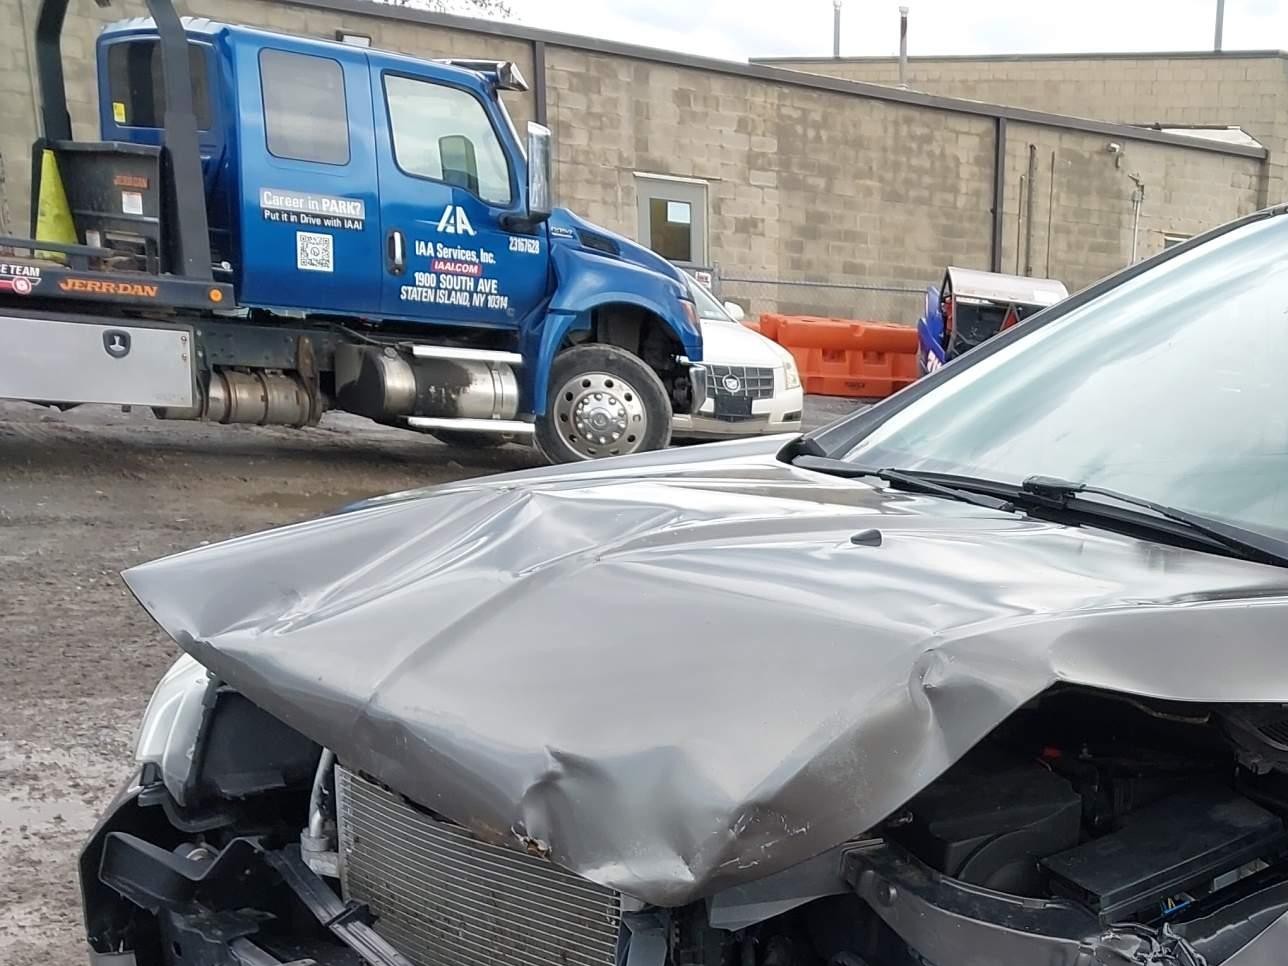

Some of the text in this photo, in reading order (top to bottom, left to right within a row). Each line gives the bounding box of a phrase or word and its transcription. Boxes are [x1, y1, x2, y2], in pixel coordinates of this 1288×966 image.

[263, 191, 361, 215] Career in PARK?
[264, 209, 279, 220] Put
[281, 211, 288, 222] it
[290, 212, 298, 223] in
[300, 214, 321, 225] Drive
[323, 218, 341, 227] with
[415, 240, 496, 265] IAA Services, Inc.
[9, 264, 41, 277] TEAM
[414, 272, 499, 293] 1900 SOUTH AVE
[400, 286, 435, 302] STATEN
[472, 293, 486, 307] NY
[487, 294, 509, 310] 10314
